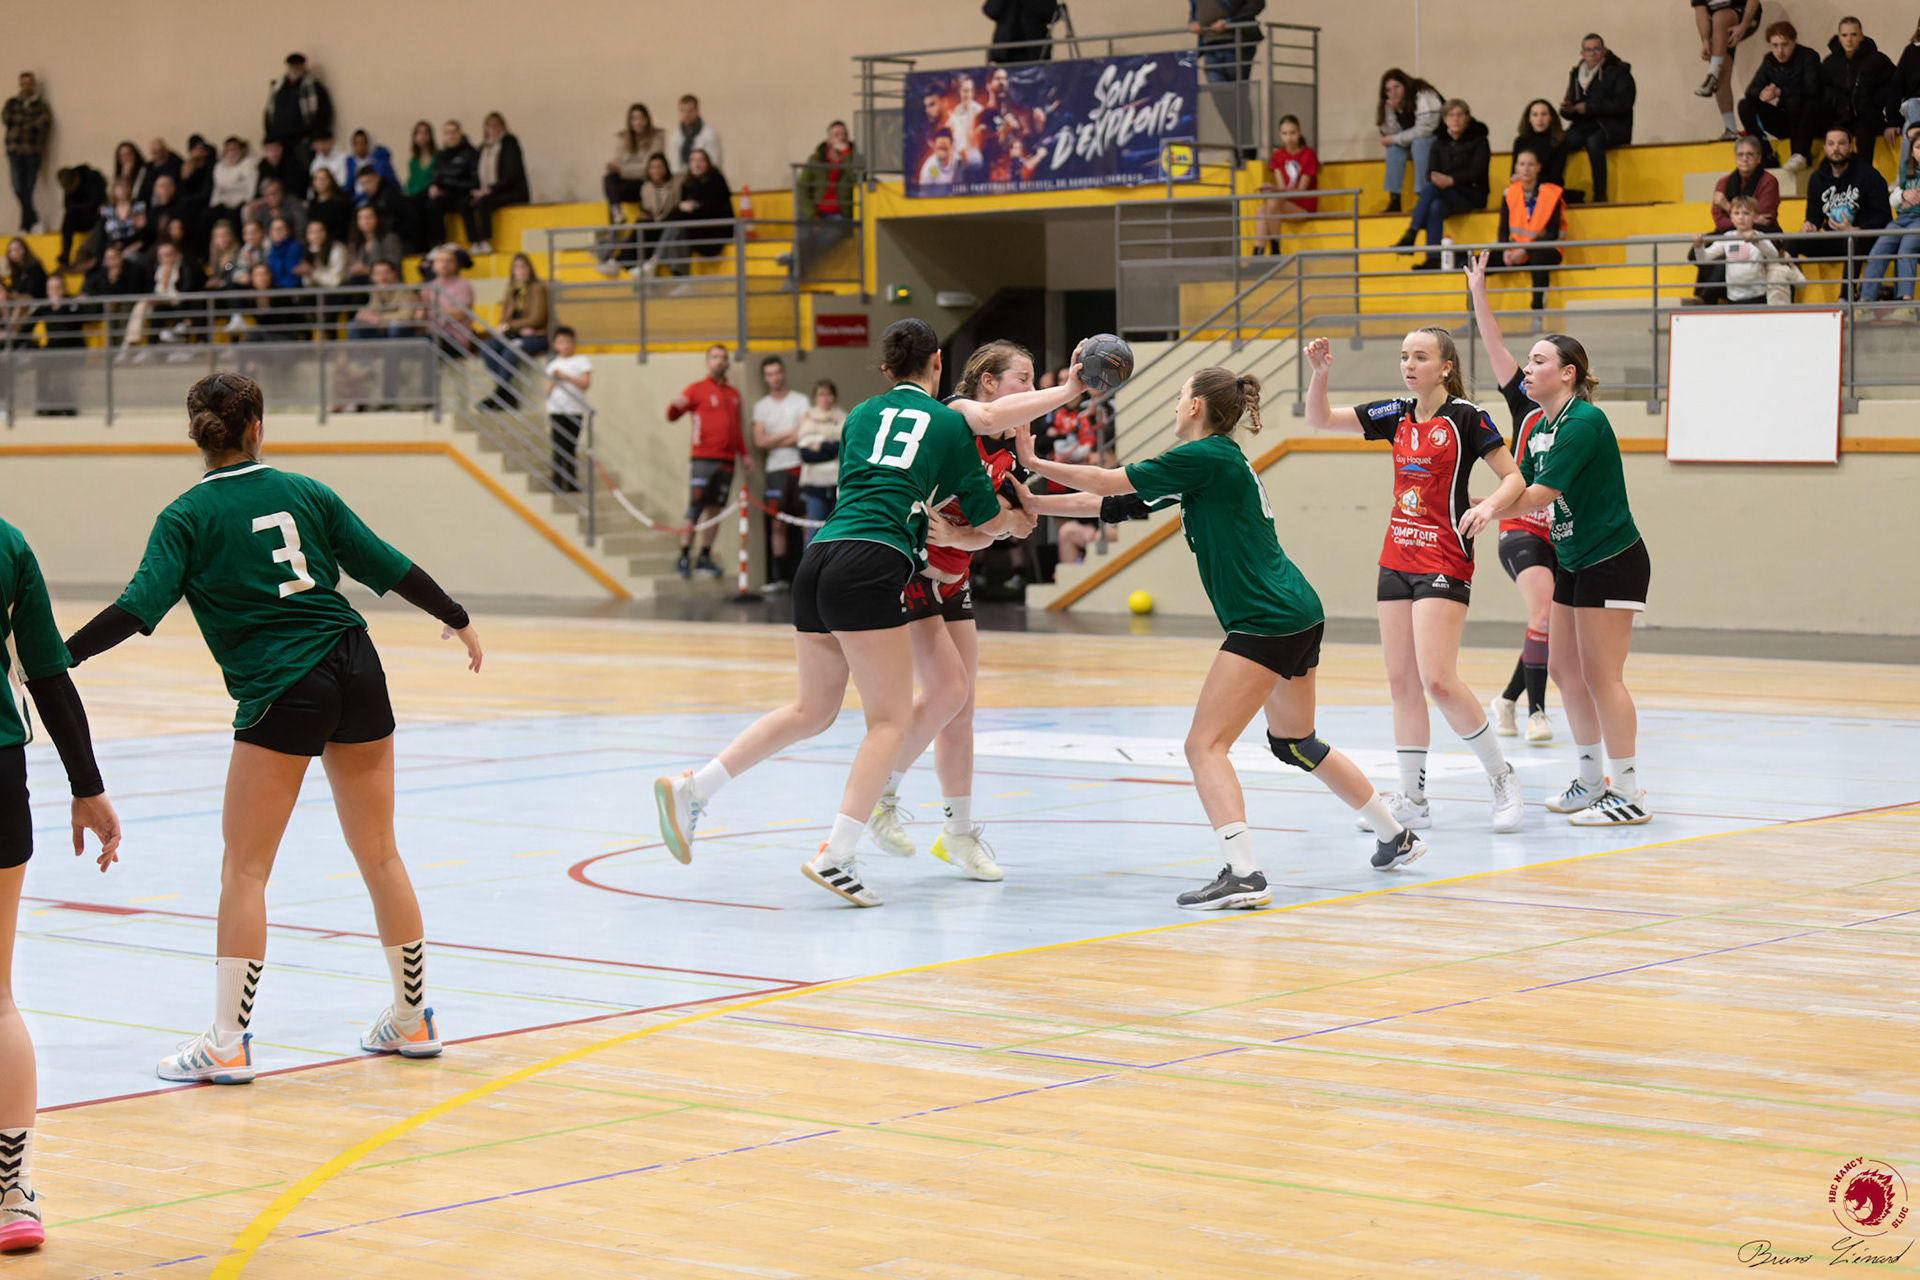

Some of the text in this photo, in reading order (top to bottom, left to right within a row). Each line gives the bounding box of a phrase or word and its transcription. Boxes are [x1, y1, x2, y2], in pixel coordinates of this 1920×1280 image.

[1050, 92, 1184, 170] D'EXPLOITS
[866, 407, 931, 469] 13
[1368, 403, 1392, 417] Grand
[1395, 454, 1432, 465] Guy Hoquet
[251, 511, 316, 599] 3
